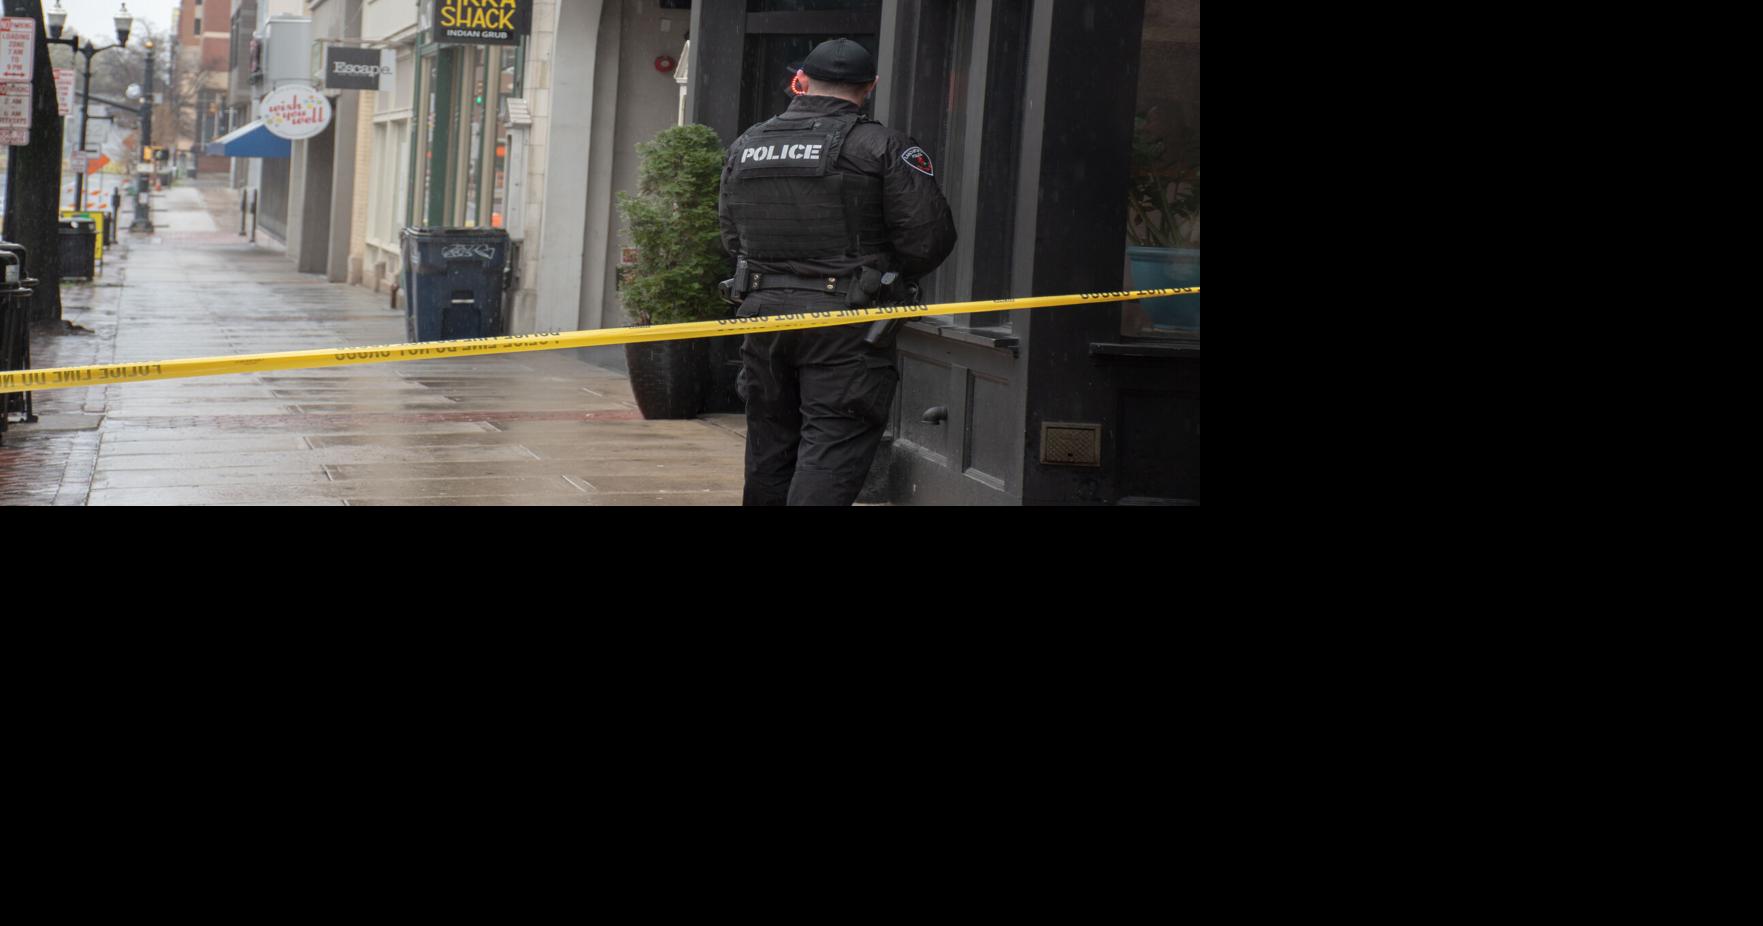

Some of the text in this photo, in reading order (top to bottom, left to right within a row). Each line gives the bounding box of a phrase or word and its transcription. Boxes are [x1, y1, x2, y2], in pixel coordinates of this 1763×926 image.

[441, 6, 515, 29] SHACK
[481, 31, 508, 39] GRUB
[269, 95, 302, 112] wish
[292, 106, 323, 125] well
[741, 144, 822, 163] POLICE
